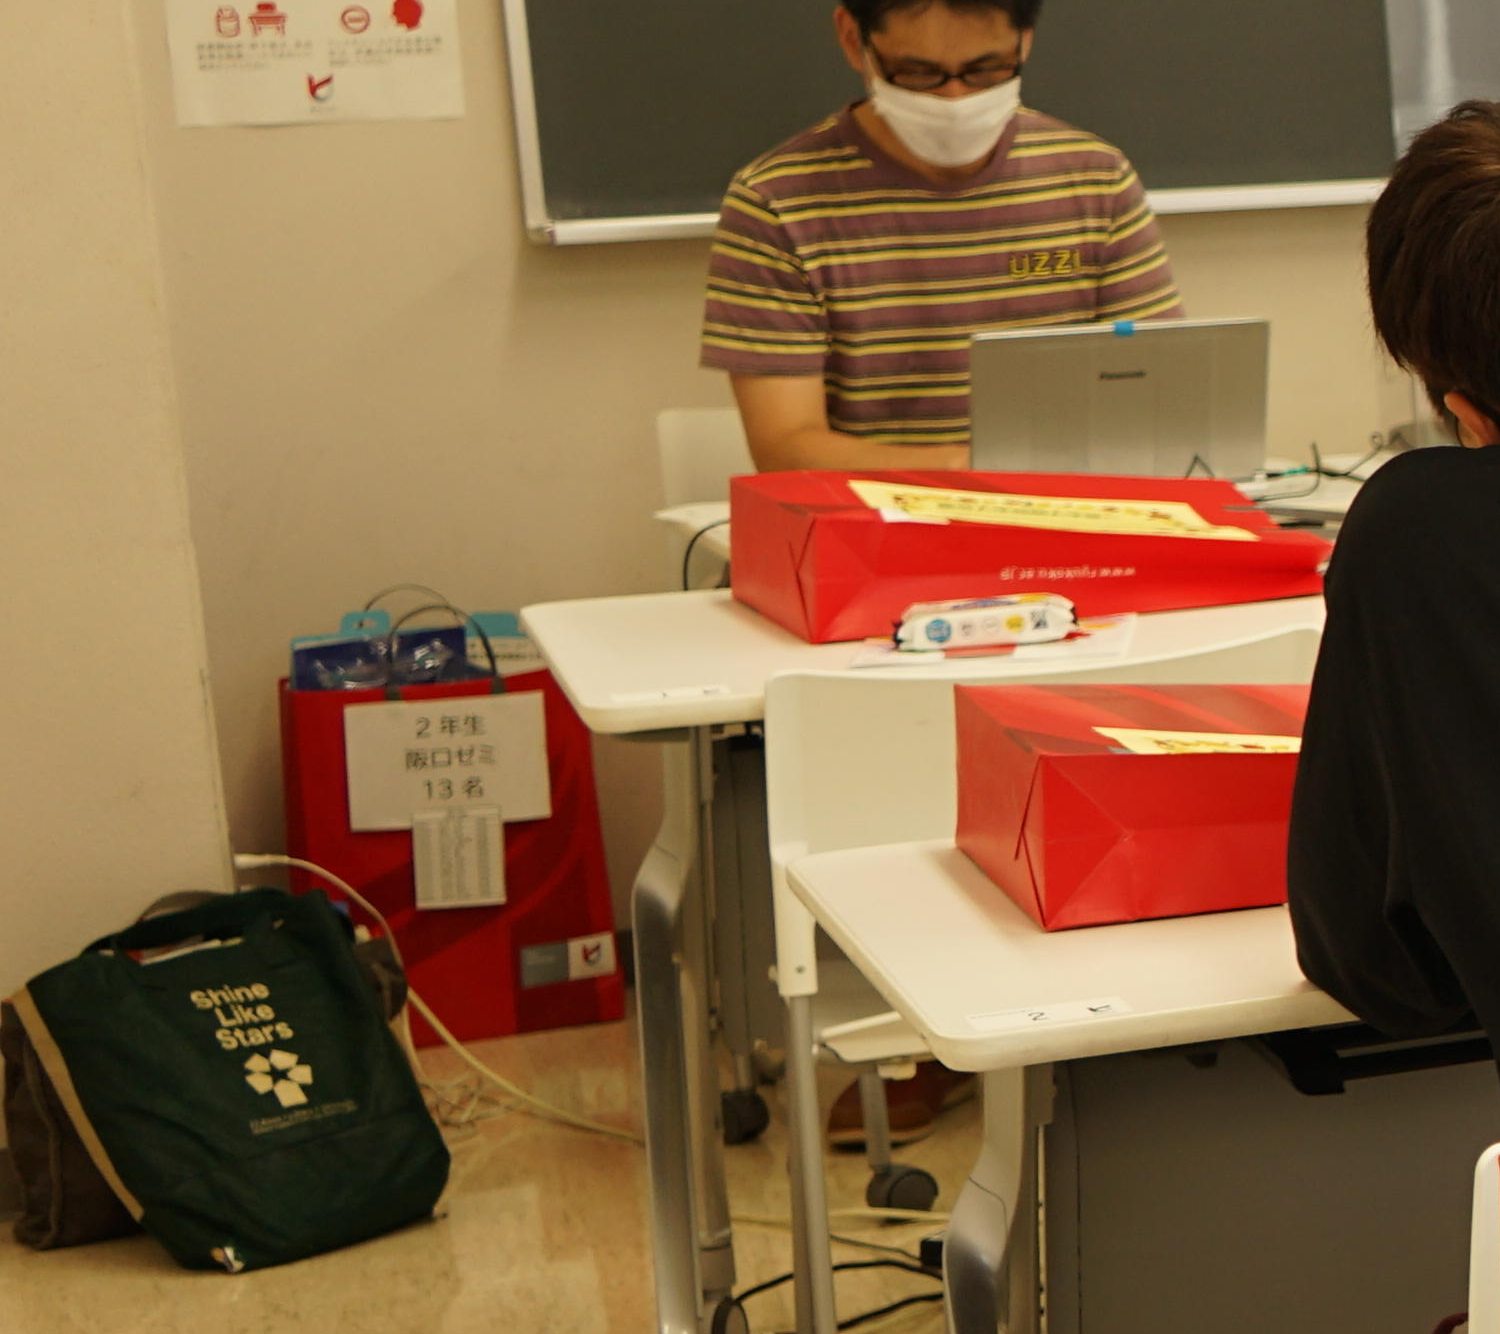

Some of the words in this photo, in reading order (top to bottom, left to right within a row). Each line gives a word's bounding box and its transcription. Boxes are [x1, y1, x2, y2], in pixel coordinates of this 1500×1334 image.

[190, 983, 270, 1009] Shine
[214, 1004, 275, 1027] Like
[215, 1022, 293, 1050] Stars
